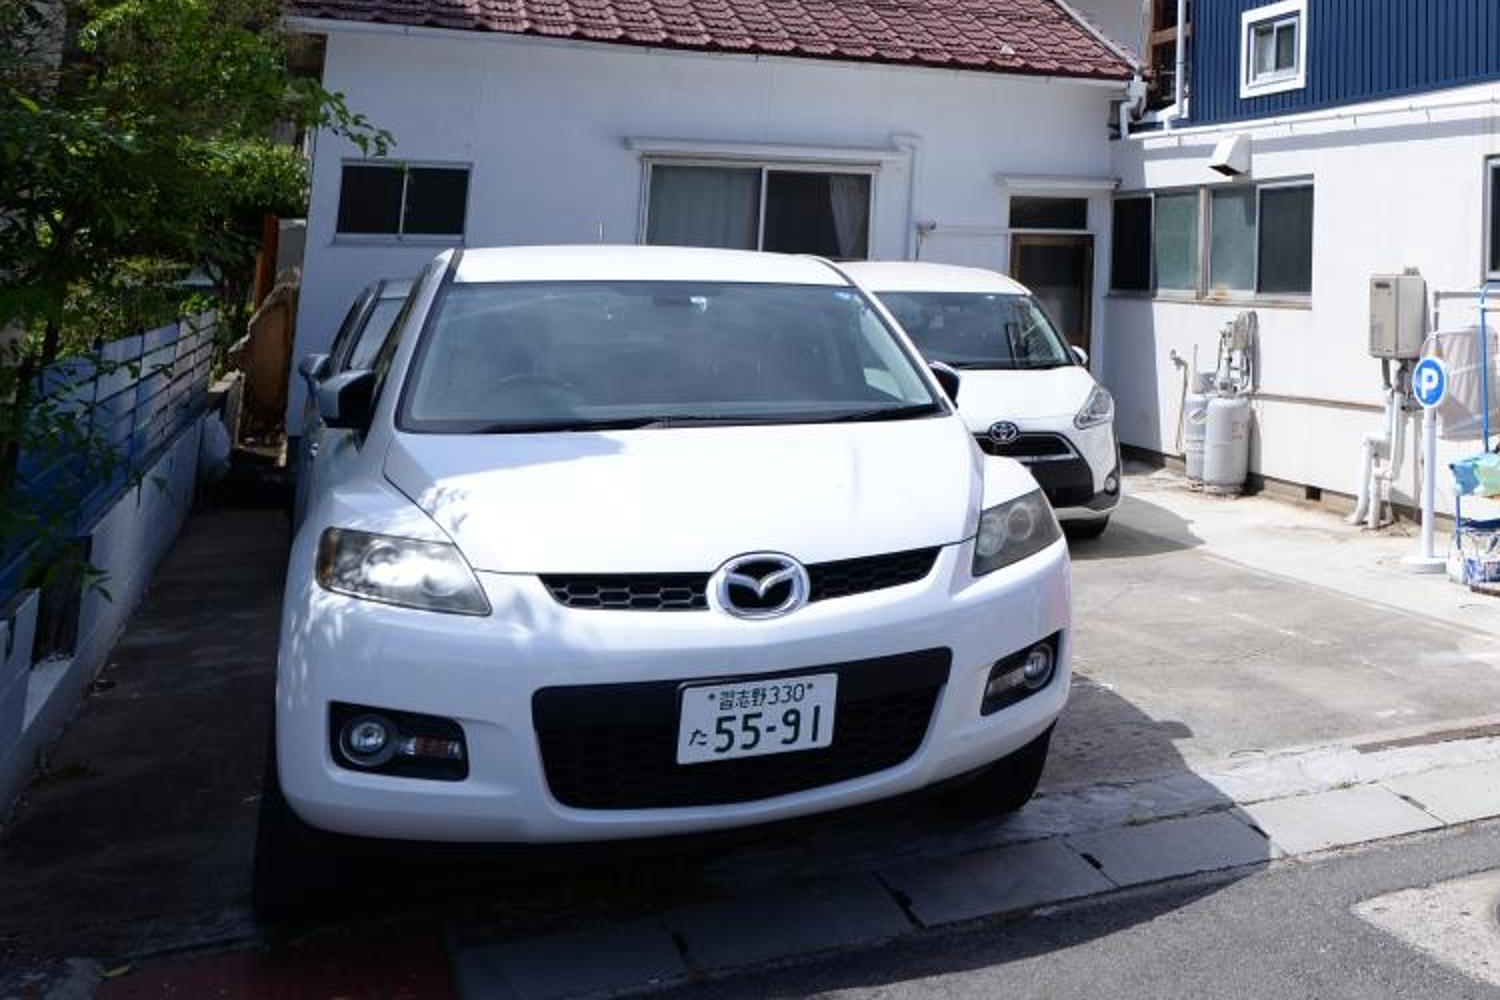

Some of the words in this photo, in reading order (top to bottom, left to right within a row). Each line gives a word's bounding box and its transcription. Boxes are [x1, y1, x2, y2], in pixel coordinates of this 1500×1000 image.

[1422, 368, 1438, 399] P
[689, 728, 707, 746] た
[714, 705, 820, 753] 55-91
